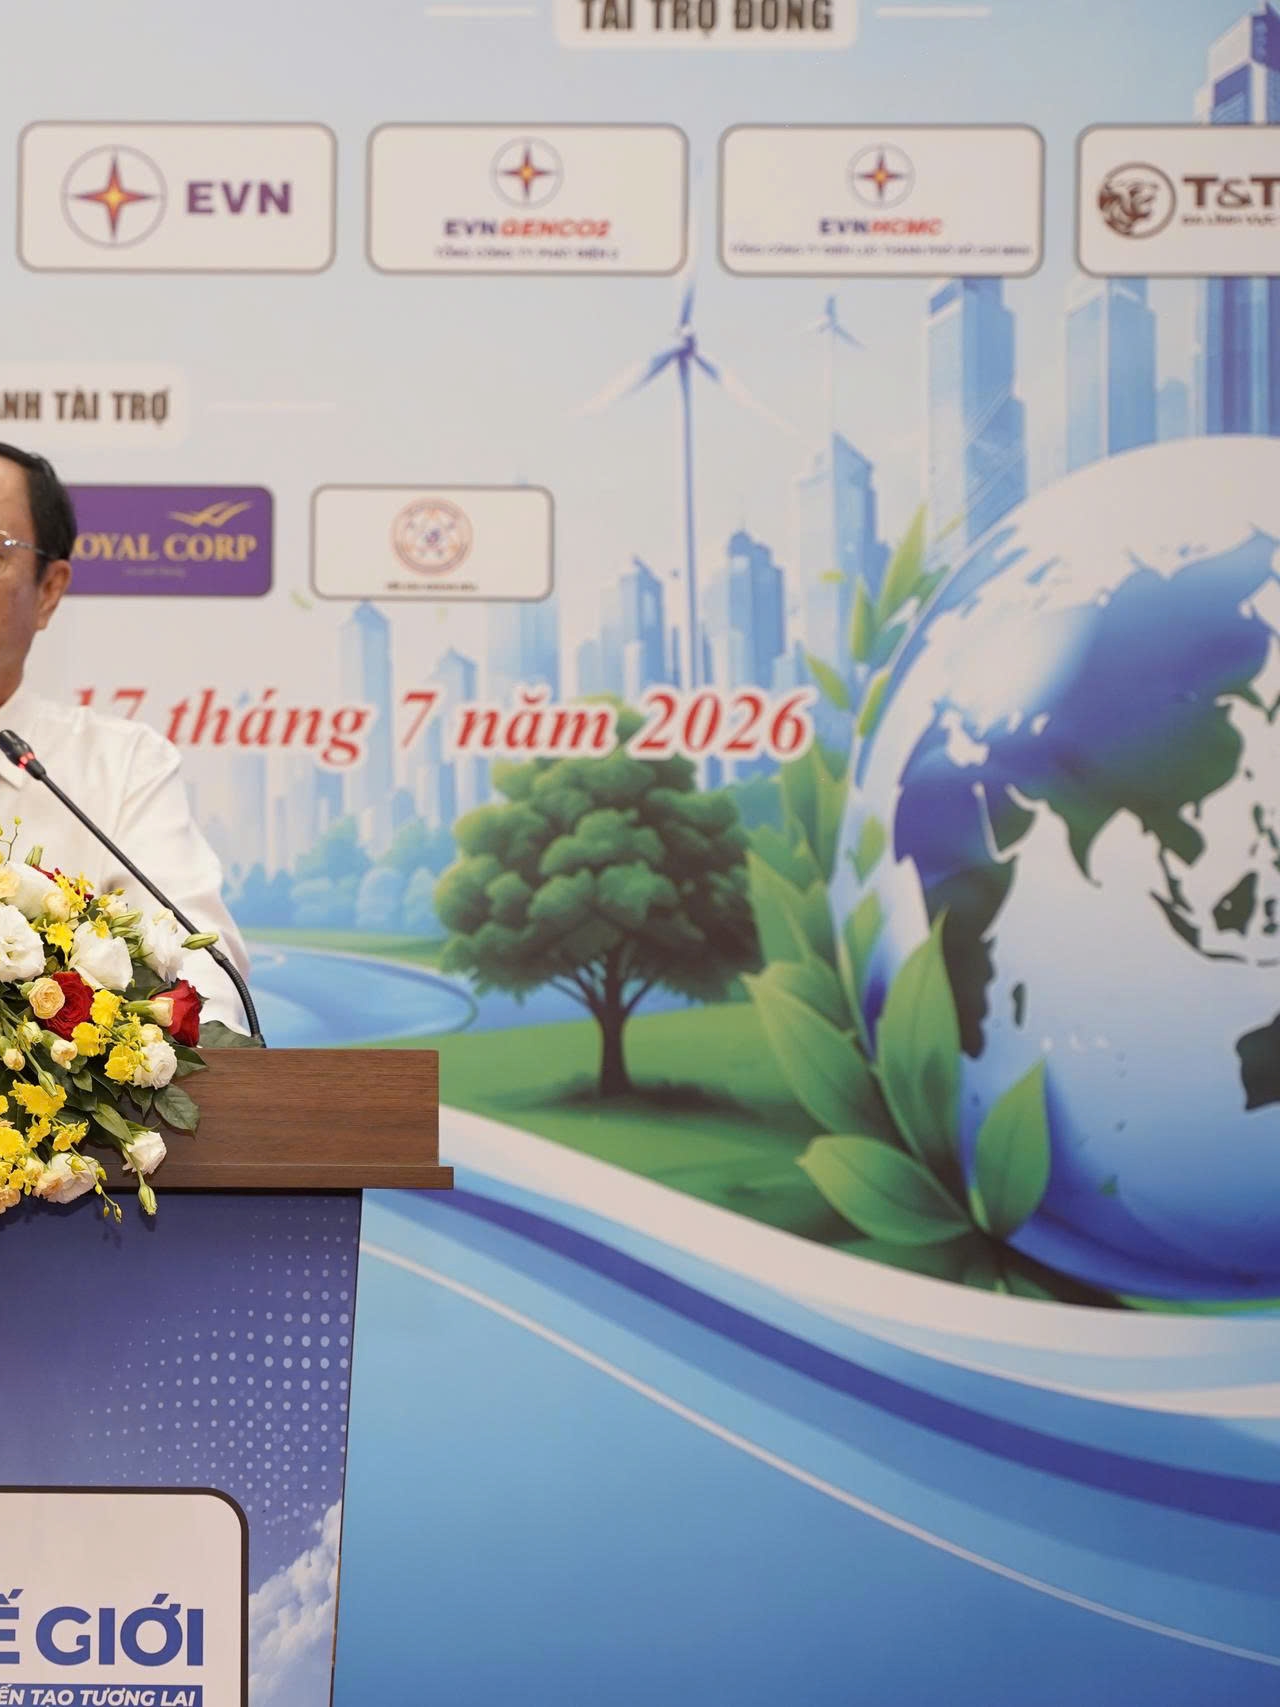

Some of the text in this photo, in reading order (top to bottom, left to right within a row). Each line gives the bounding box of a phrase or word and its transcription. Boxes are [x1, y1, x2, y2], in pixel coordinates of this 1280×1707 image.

[186, 181, 292, 215] EVN
[1182, 176, 1280, 208] T&T
[54, 386, 100, 421] TÀI
[111, 386, 171, 427] TRỢ
[71, 532, 257, 562] OYAL CORP
[166, 687, 366, 763] tháng
[402, 691, 437, 748] 7
[456, 690, 611, 751] năm
[639, 692, 807, 753] 2026
[36, 1594, 204, 1667] GIỚI
[31, 1688, 75, 1707] TẠO
[79, 1687, 156, 1707] TƯƠNG
[160, 1690, 196, 1707] LAI
